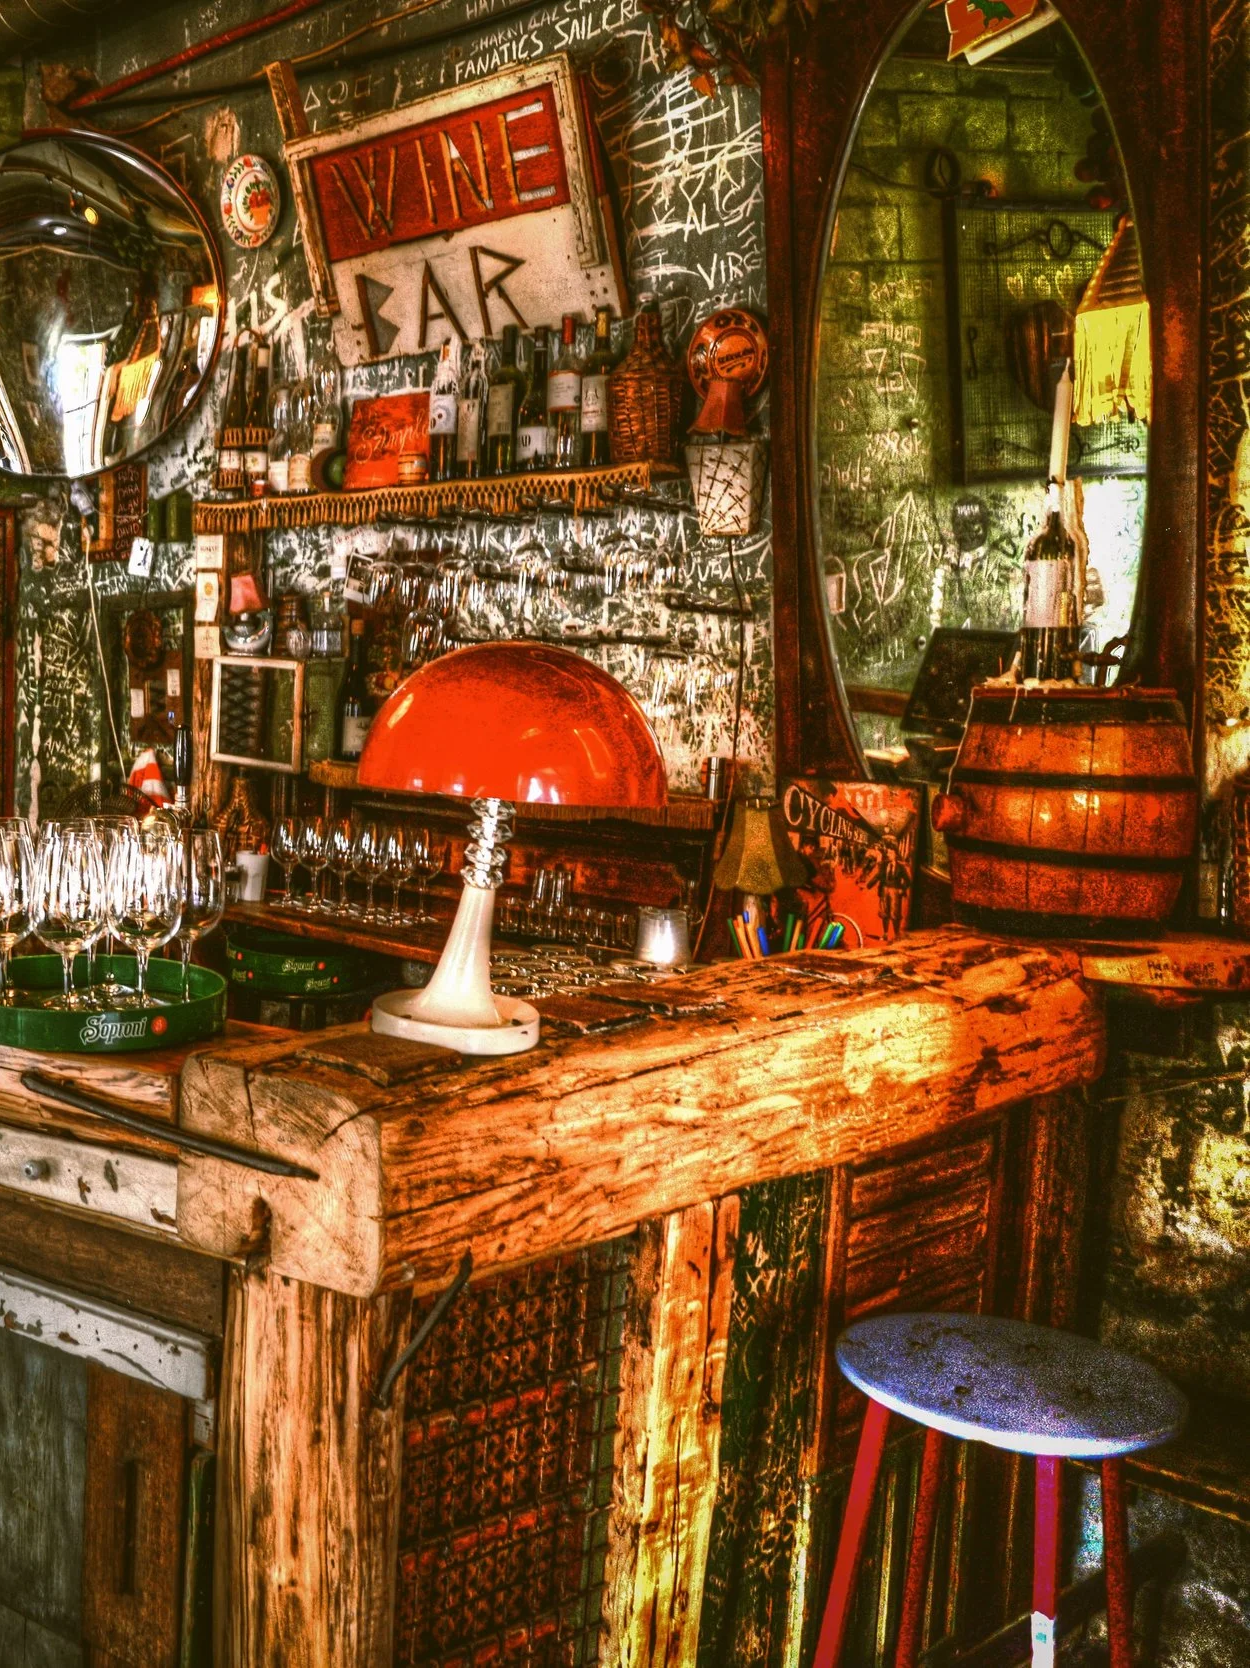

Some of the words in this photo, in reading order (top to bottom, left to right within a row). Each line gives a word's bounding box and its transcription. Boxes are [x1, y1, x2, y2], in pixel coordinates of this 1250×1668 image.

[455, 31, 544, 85] FANATICS
[330, 101, 558, 241] WINE
[355, 245, 529, 358] BAR
[783, 784, 853, 840] CYCLING
[79, 1013, 148, 1046] Soproni
